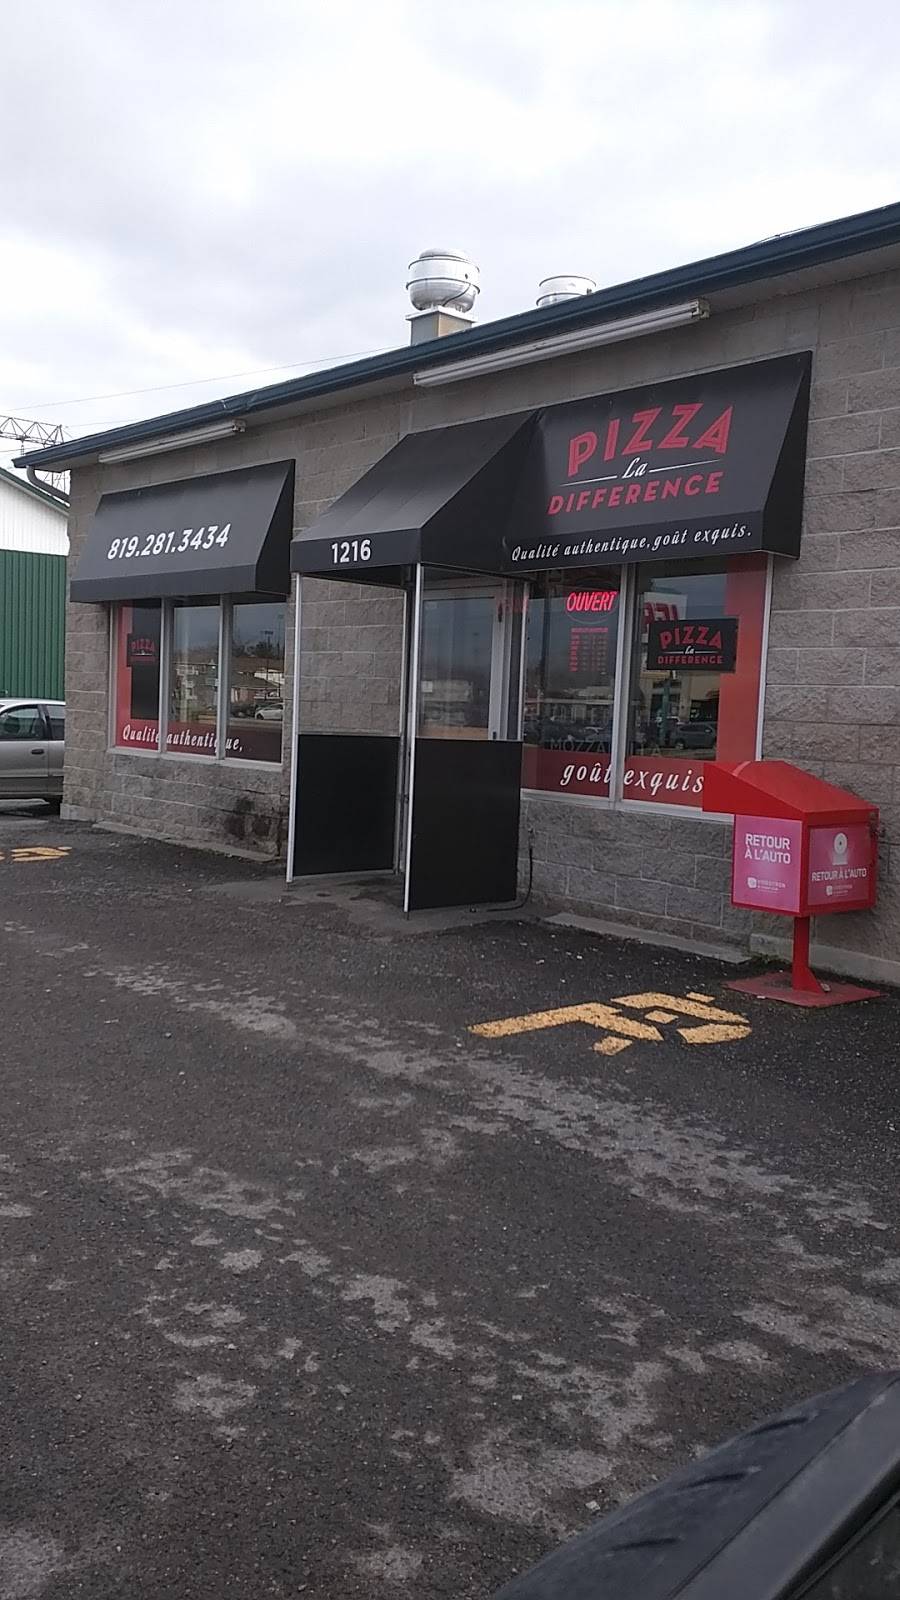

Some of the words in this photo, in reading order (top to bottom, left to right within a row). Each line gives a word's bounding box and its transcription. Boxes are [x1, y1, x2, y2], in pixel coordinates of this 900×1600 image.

[567, 402, 734, 477] PIZZA
[621, 457, 647, 479] La
[547, 471, 724, 515] DIFFERENCE
[107, 523, 232, 560] 819.281.3434
[331, 539, 371, 564] 1216
[511, 544, 560, 561] Qualité
[694, 522, 752, 546] exquis.
[566, 591, 618, 612] OUVERT
[659, 625, 723, 650] PIZZA
[657, 655, 724, 665] DIFFERENCE
[684, 644, 695, 655] La
[624, 769, 704, 795] exquis
[745, 833, 790, 850] RETOUR
[744, 845, 753, 859] À
[755, 850, 791, 864] L'AUTO
[811, 871, 838, 882] RETOUR
[845, 868, 868, 879] L'AUTO
